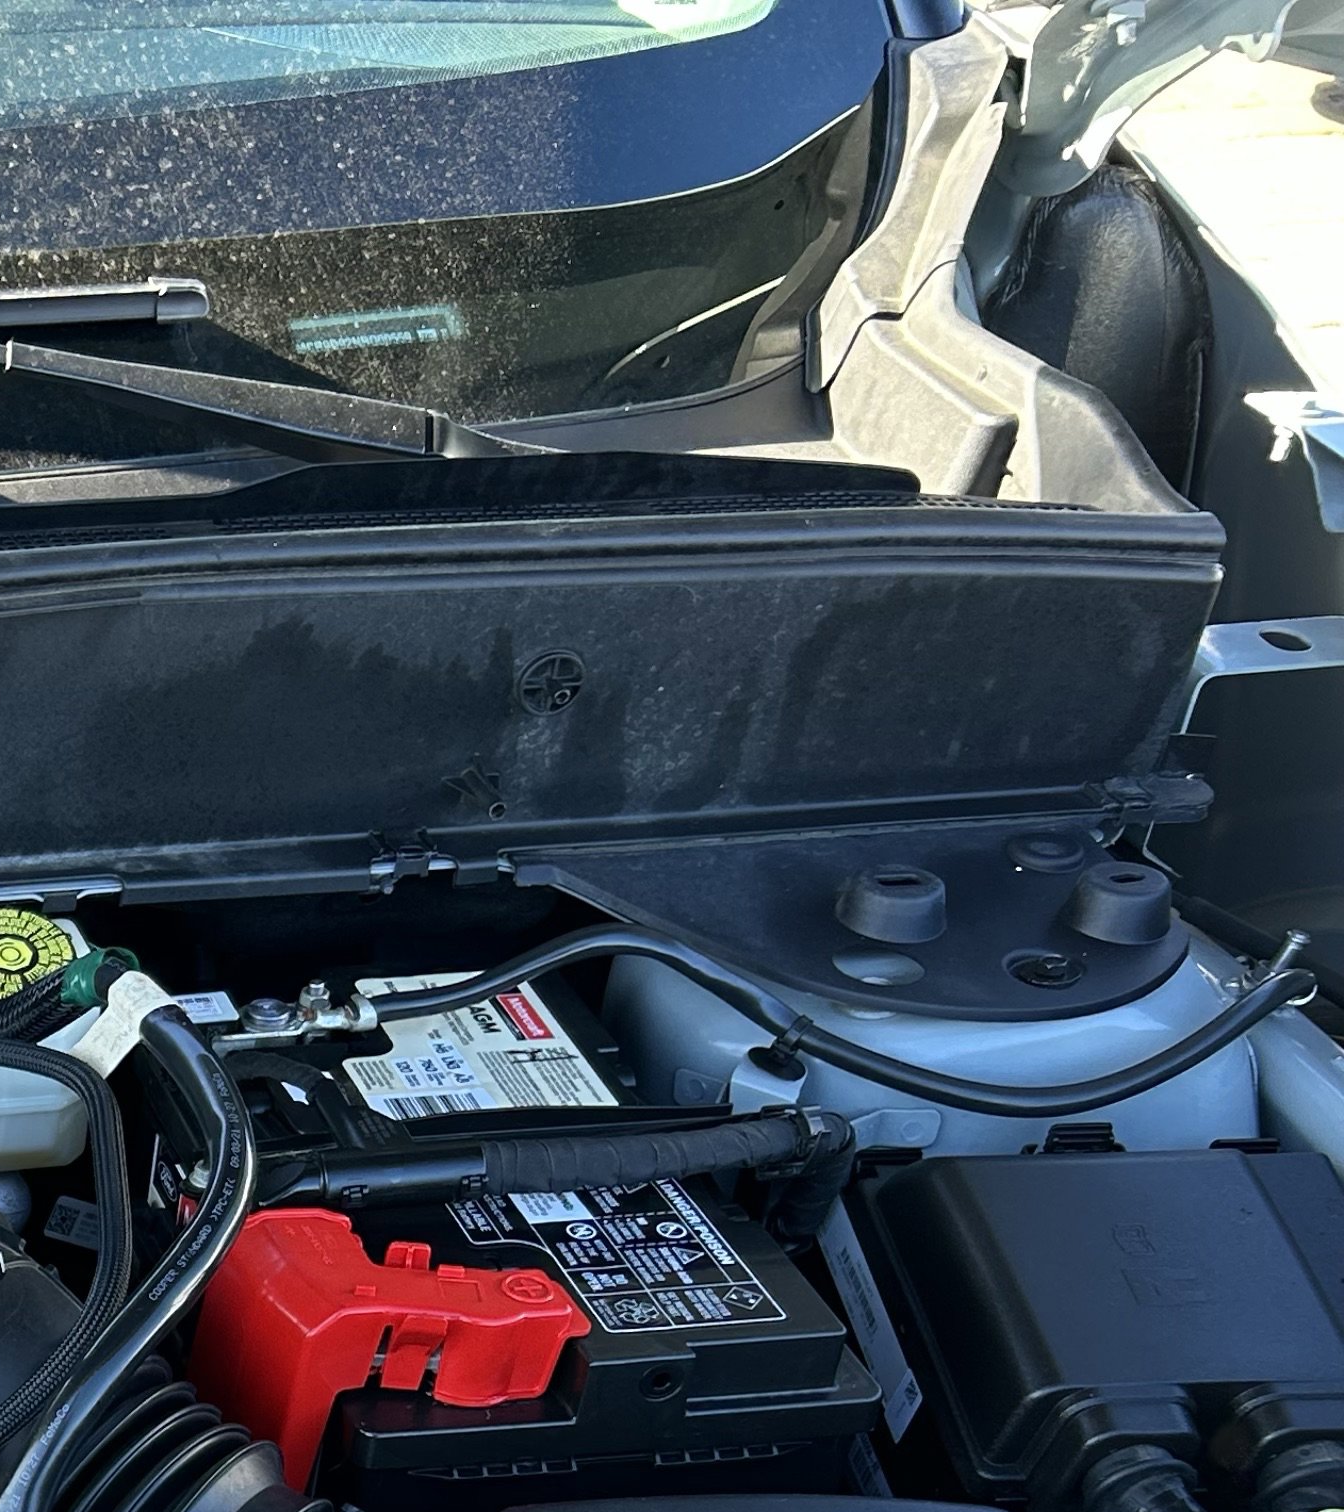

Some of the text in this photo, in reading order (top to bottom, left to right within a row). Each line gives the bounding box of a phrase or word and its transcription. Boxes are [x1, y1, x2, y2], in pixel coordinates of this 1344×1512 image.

[467, 1004, 502, 1035] AGM
[507, 996, 545, 1037] Motorcraft
[148, 1267, 180, 1302] COOPER
[178, 1224, 212, 1269] STANDARD
[39, 1402, 71, 1447] FoMoCo
